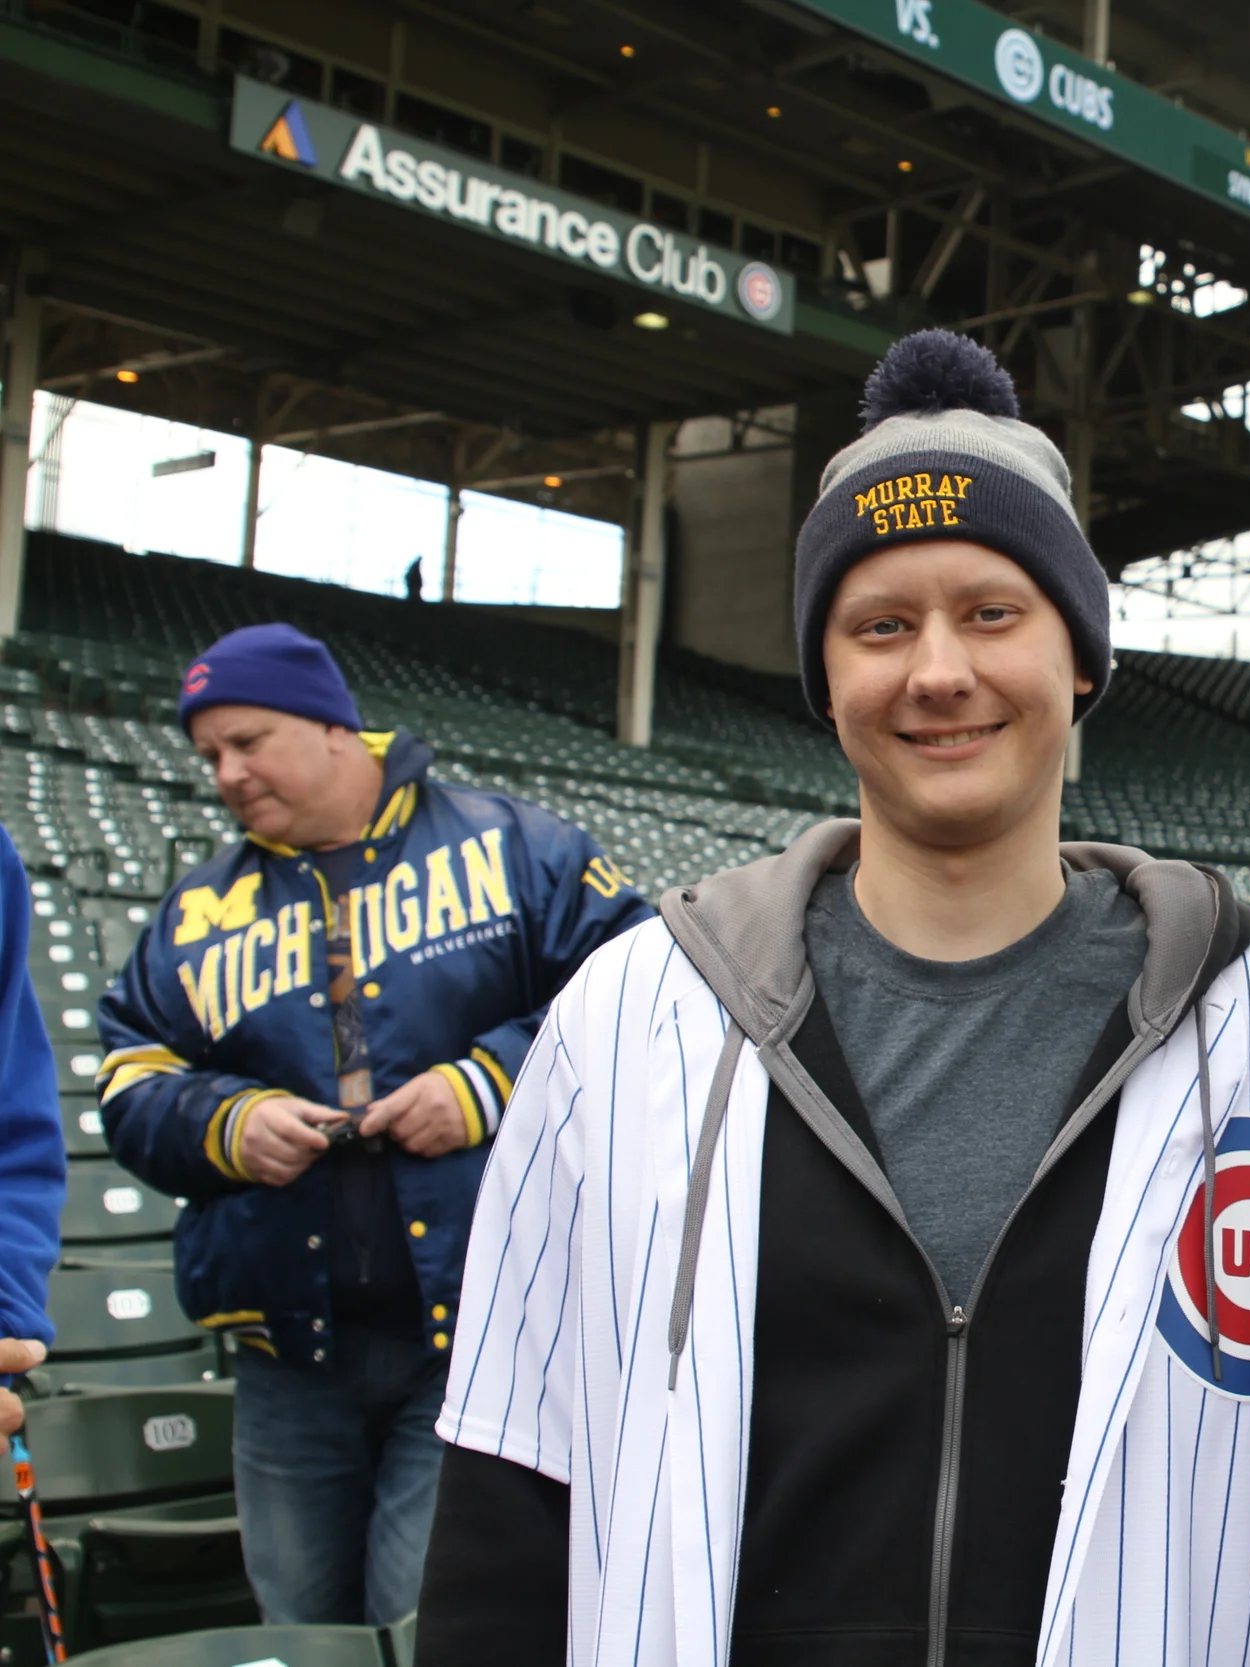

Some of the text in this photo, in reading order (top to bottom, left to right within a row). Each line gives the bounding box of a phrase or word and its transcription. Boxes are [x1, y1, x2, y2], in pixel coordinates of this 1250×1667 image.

[1049, 64, 1114, 130] CUBS
[340, 124, 727, 304] Assurance Club
[855, 473, 973, 517] MURRAY
[873, 500, 959, 534] STATE
[184, 663, 211, 695] C
[174, 872, 263, 946] M
[153, 1419, 188, 1444] 102
